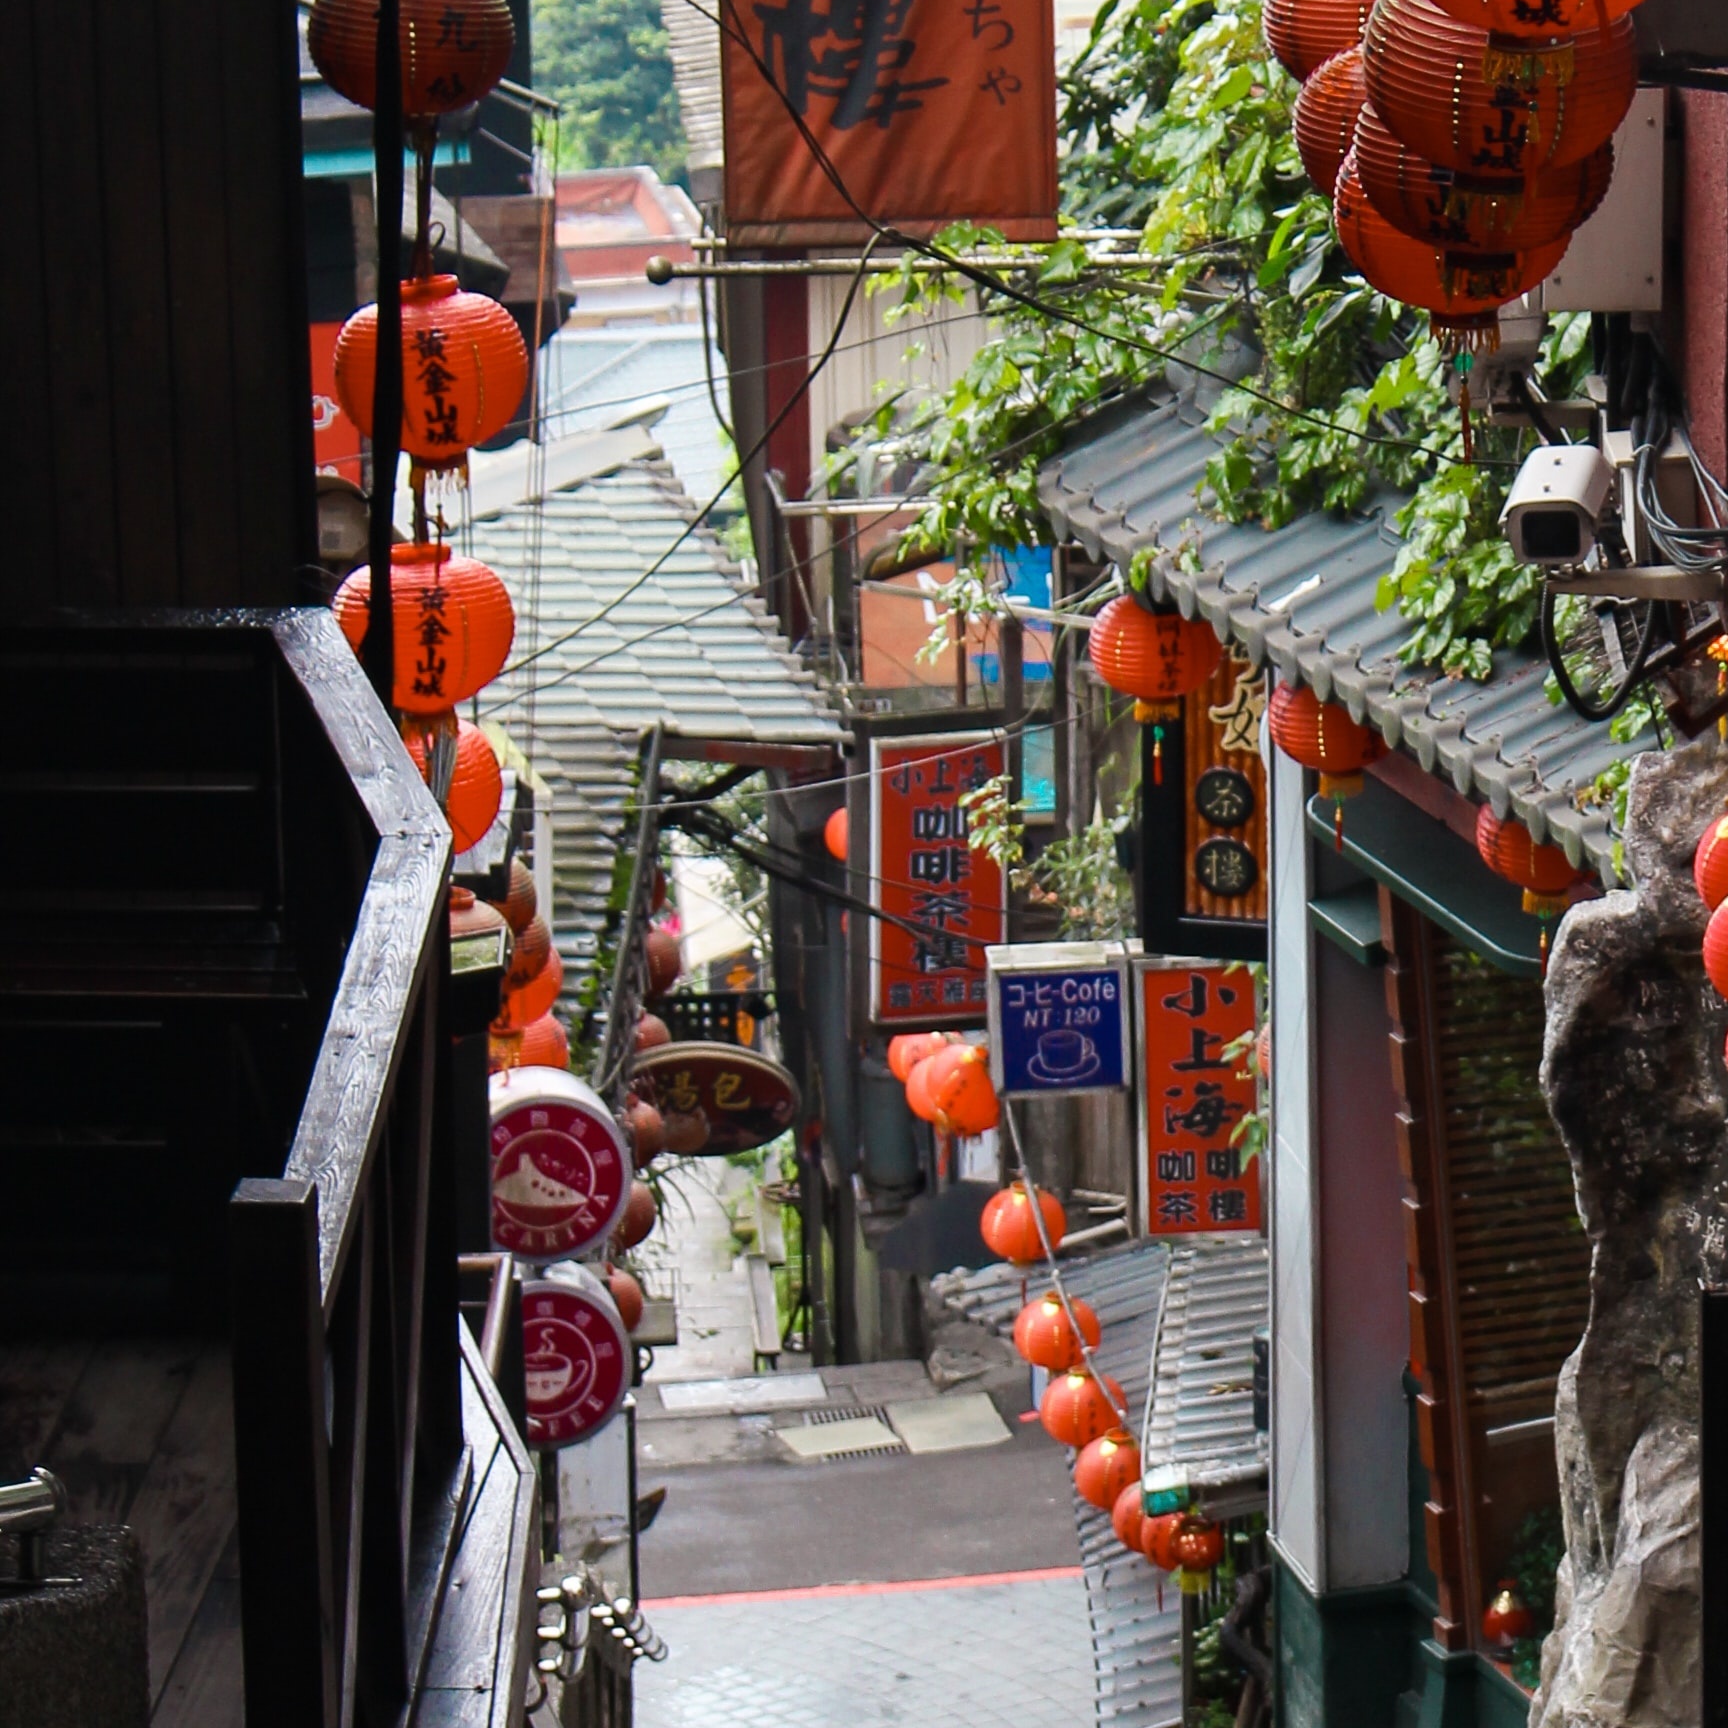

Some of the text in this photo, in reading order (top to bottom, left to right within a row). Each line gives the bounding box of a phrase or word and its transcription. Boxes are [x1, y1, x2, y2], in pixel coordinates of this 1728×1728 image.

[1162, 973, 1245, 1139] 小上海
[493, 1193, 610, 1247] CARINA
